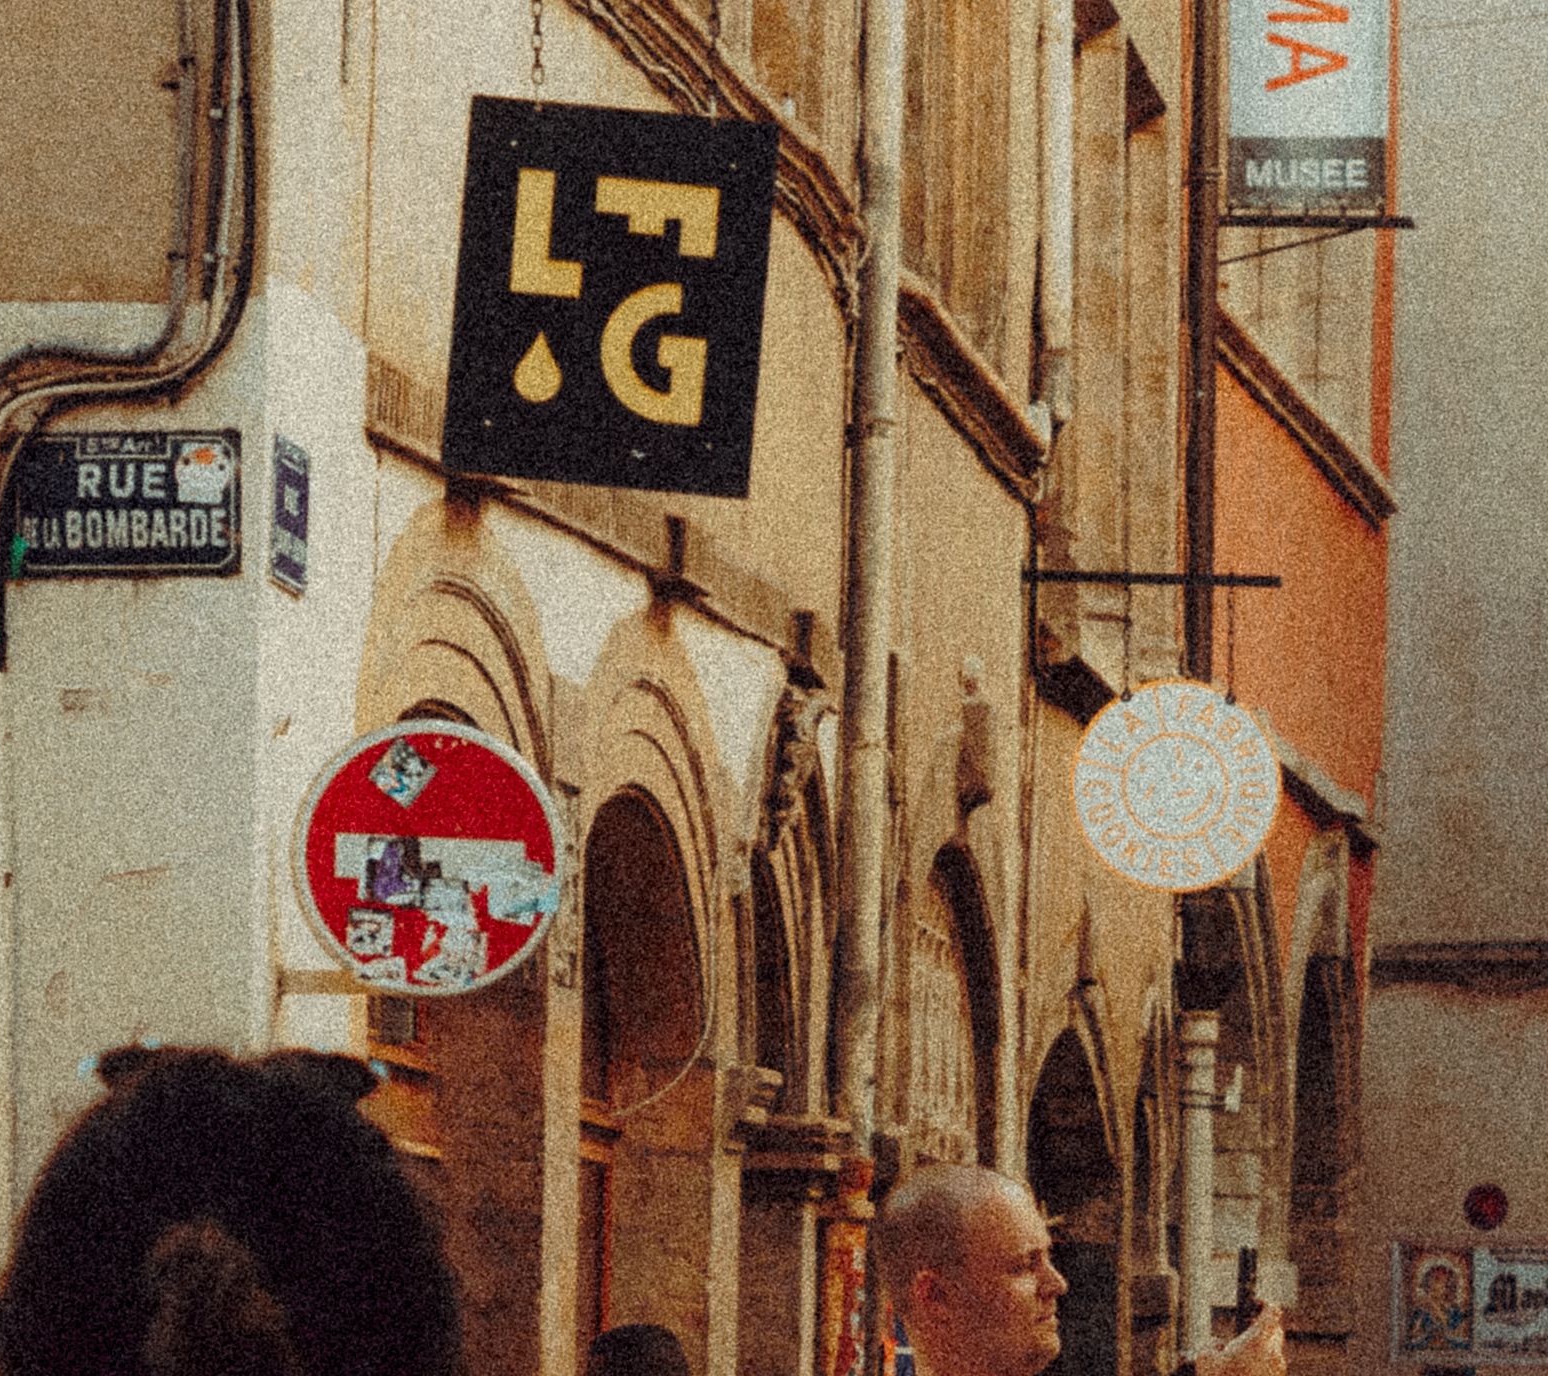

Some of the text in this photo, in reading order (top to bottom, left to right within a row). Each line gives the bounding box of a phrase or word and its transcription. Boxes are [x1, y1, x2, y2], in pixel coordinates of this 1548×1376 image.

[77, 462, 167, 499] RUE
[65, 507, 230, 549] BOMBARDE
[1081, 779, 1202, 880] COOKIES
